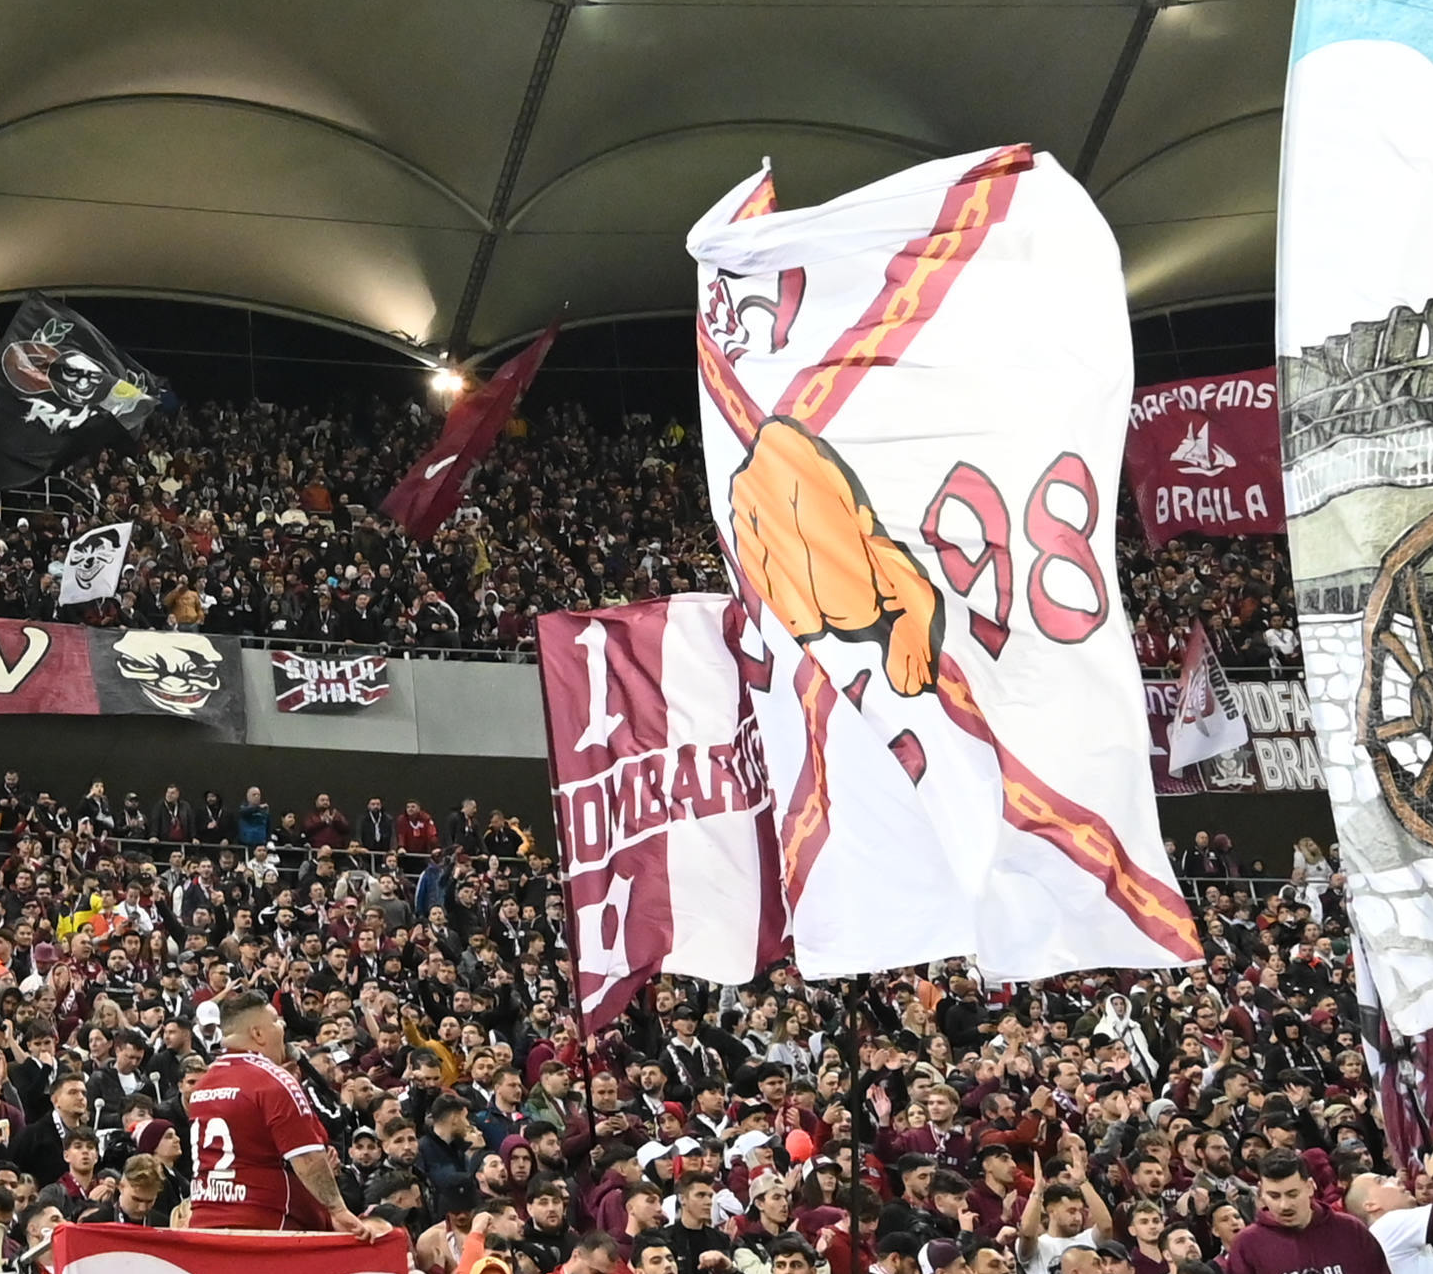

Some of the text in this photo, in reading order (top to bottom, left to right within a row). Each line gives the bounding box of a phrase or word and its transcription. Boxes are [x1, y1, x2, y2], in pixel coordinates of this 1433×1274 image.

[1155, 483, 1269, 526] BRAILA
[920, 452, 1109, 662] 98
[285, 659, 376, 681] SOUTH
[302, 680, 364, 703] SIDE
[190, 1117, 236, 1179] 12
